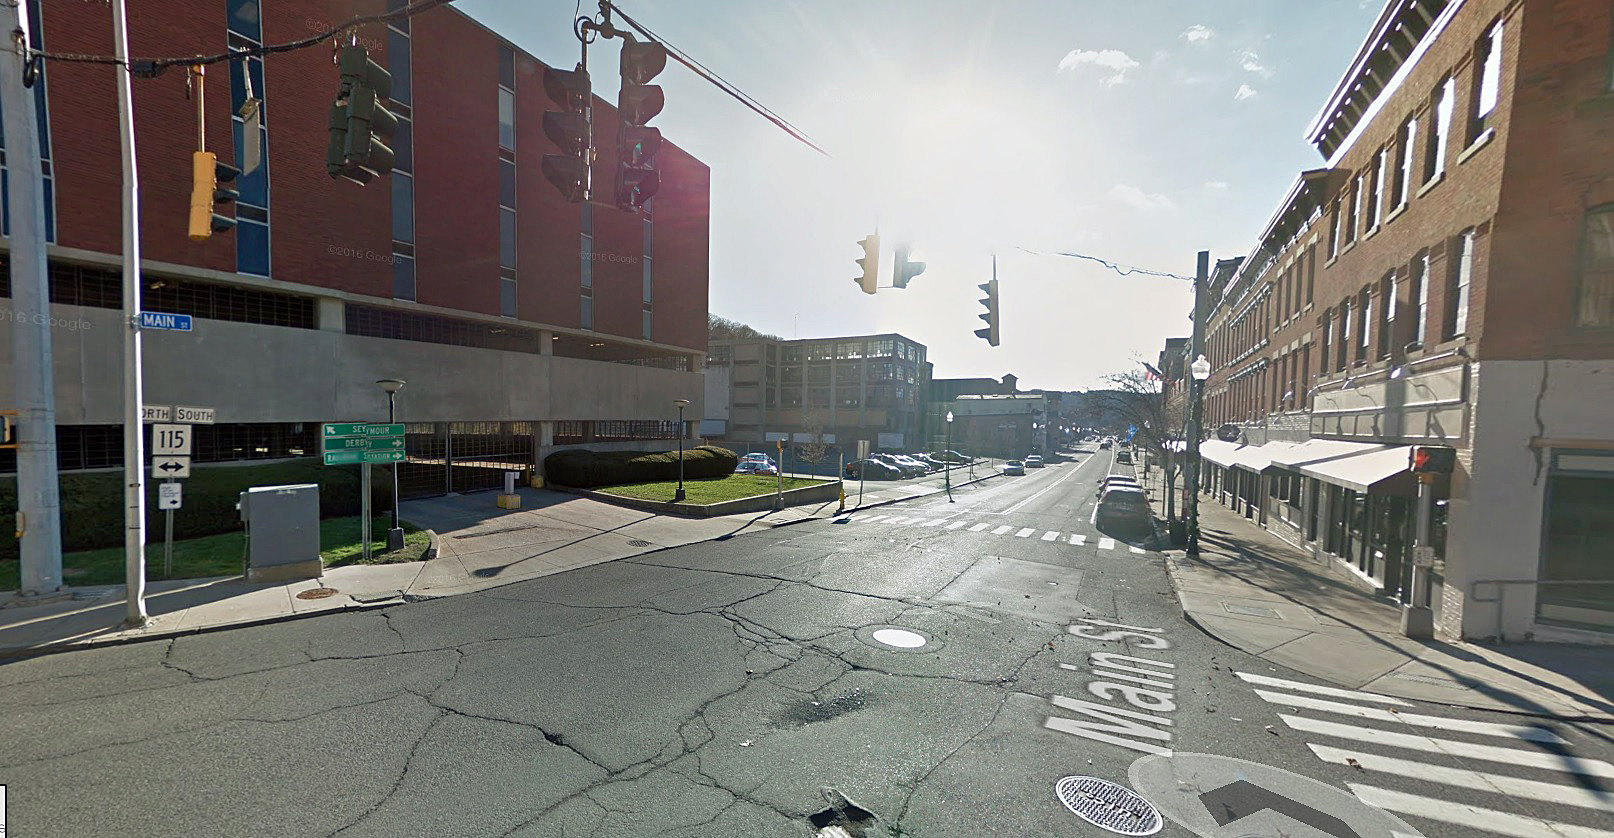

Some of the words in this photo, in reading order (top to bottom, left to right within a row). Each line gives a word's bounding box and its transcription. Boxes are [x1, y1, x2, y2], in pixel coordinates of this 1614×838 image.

[144, 313, 175, 328] MAIN
[177, 408, 213, 420] SOUTH
[159, 430, 184, 448] 115
